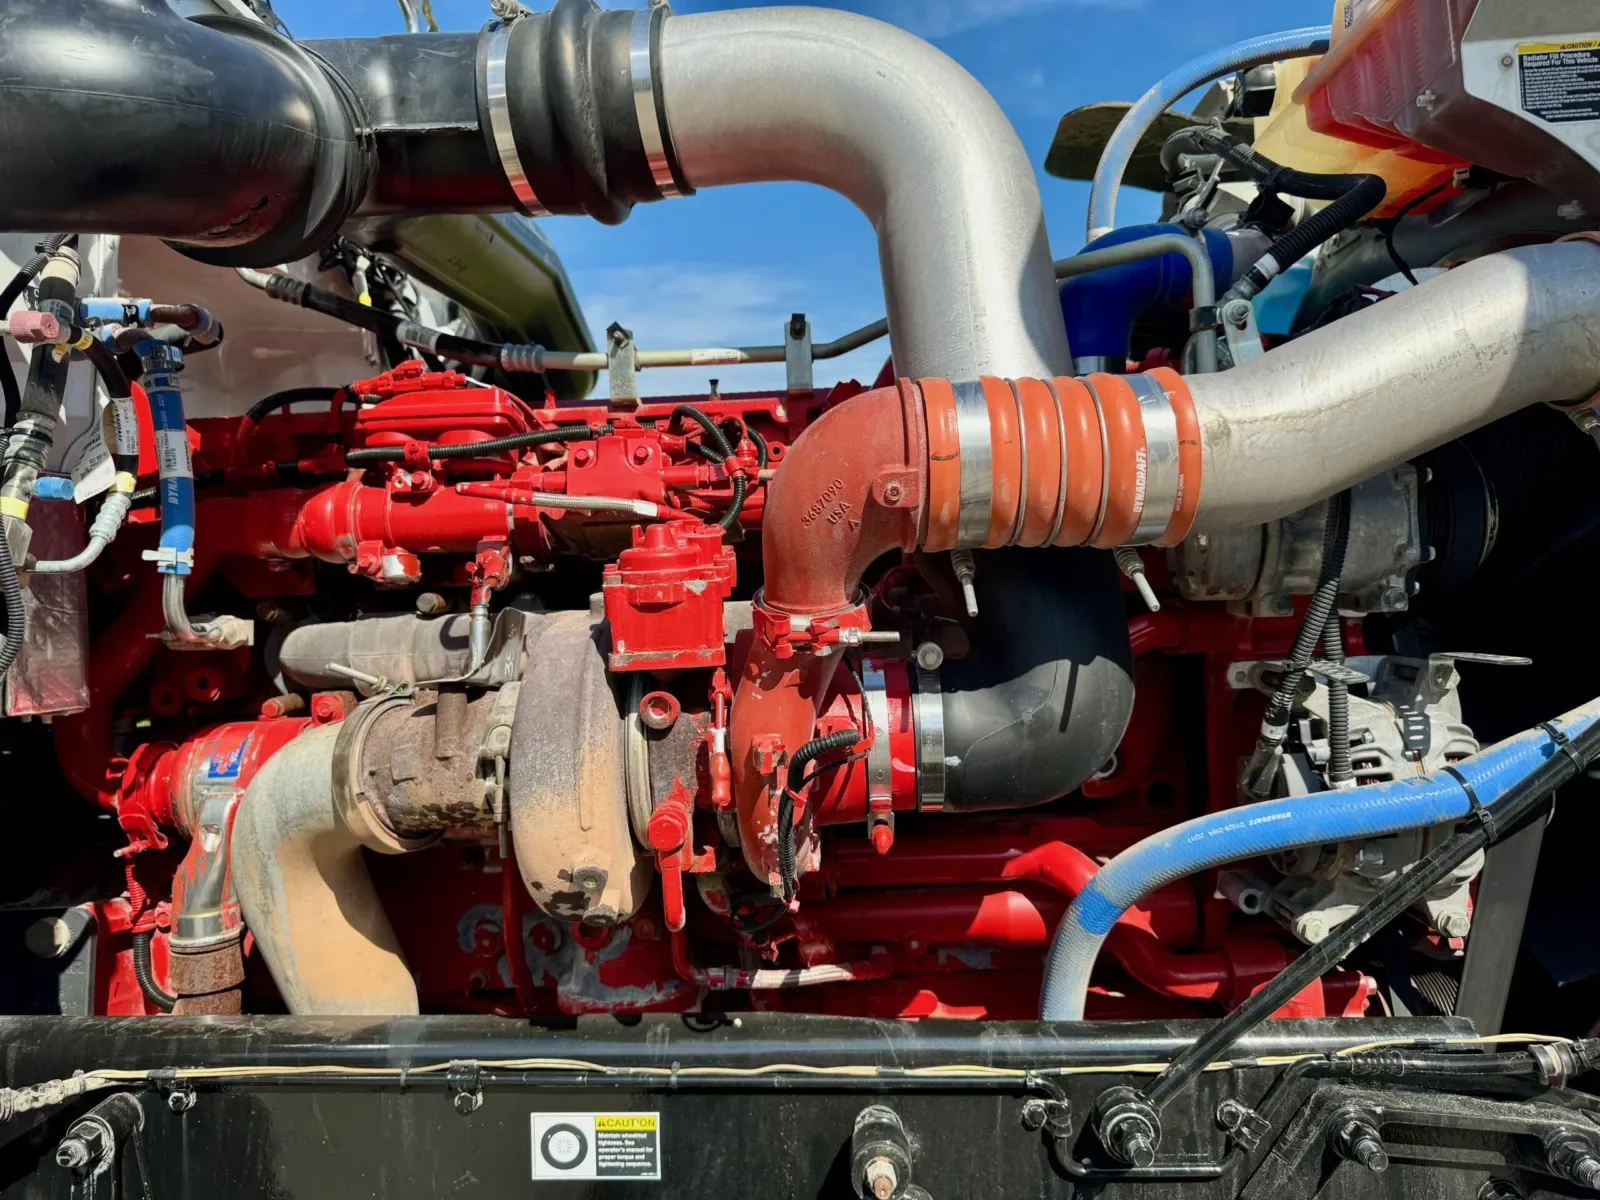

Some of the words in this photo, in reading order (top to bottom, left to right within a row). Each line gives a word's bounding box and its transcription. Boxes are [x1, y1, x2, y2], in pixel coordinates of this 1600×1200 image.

[1567, 42, 1592, 50] CAUTION
[1523, 60, 1550, 68] Required
[800, 478, 844, 529] 3687090
[826, 500, 851, 525] USA
[598, 1139, 625, 1147] tightness.
[598, 1161, 625, 1169] tightening
